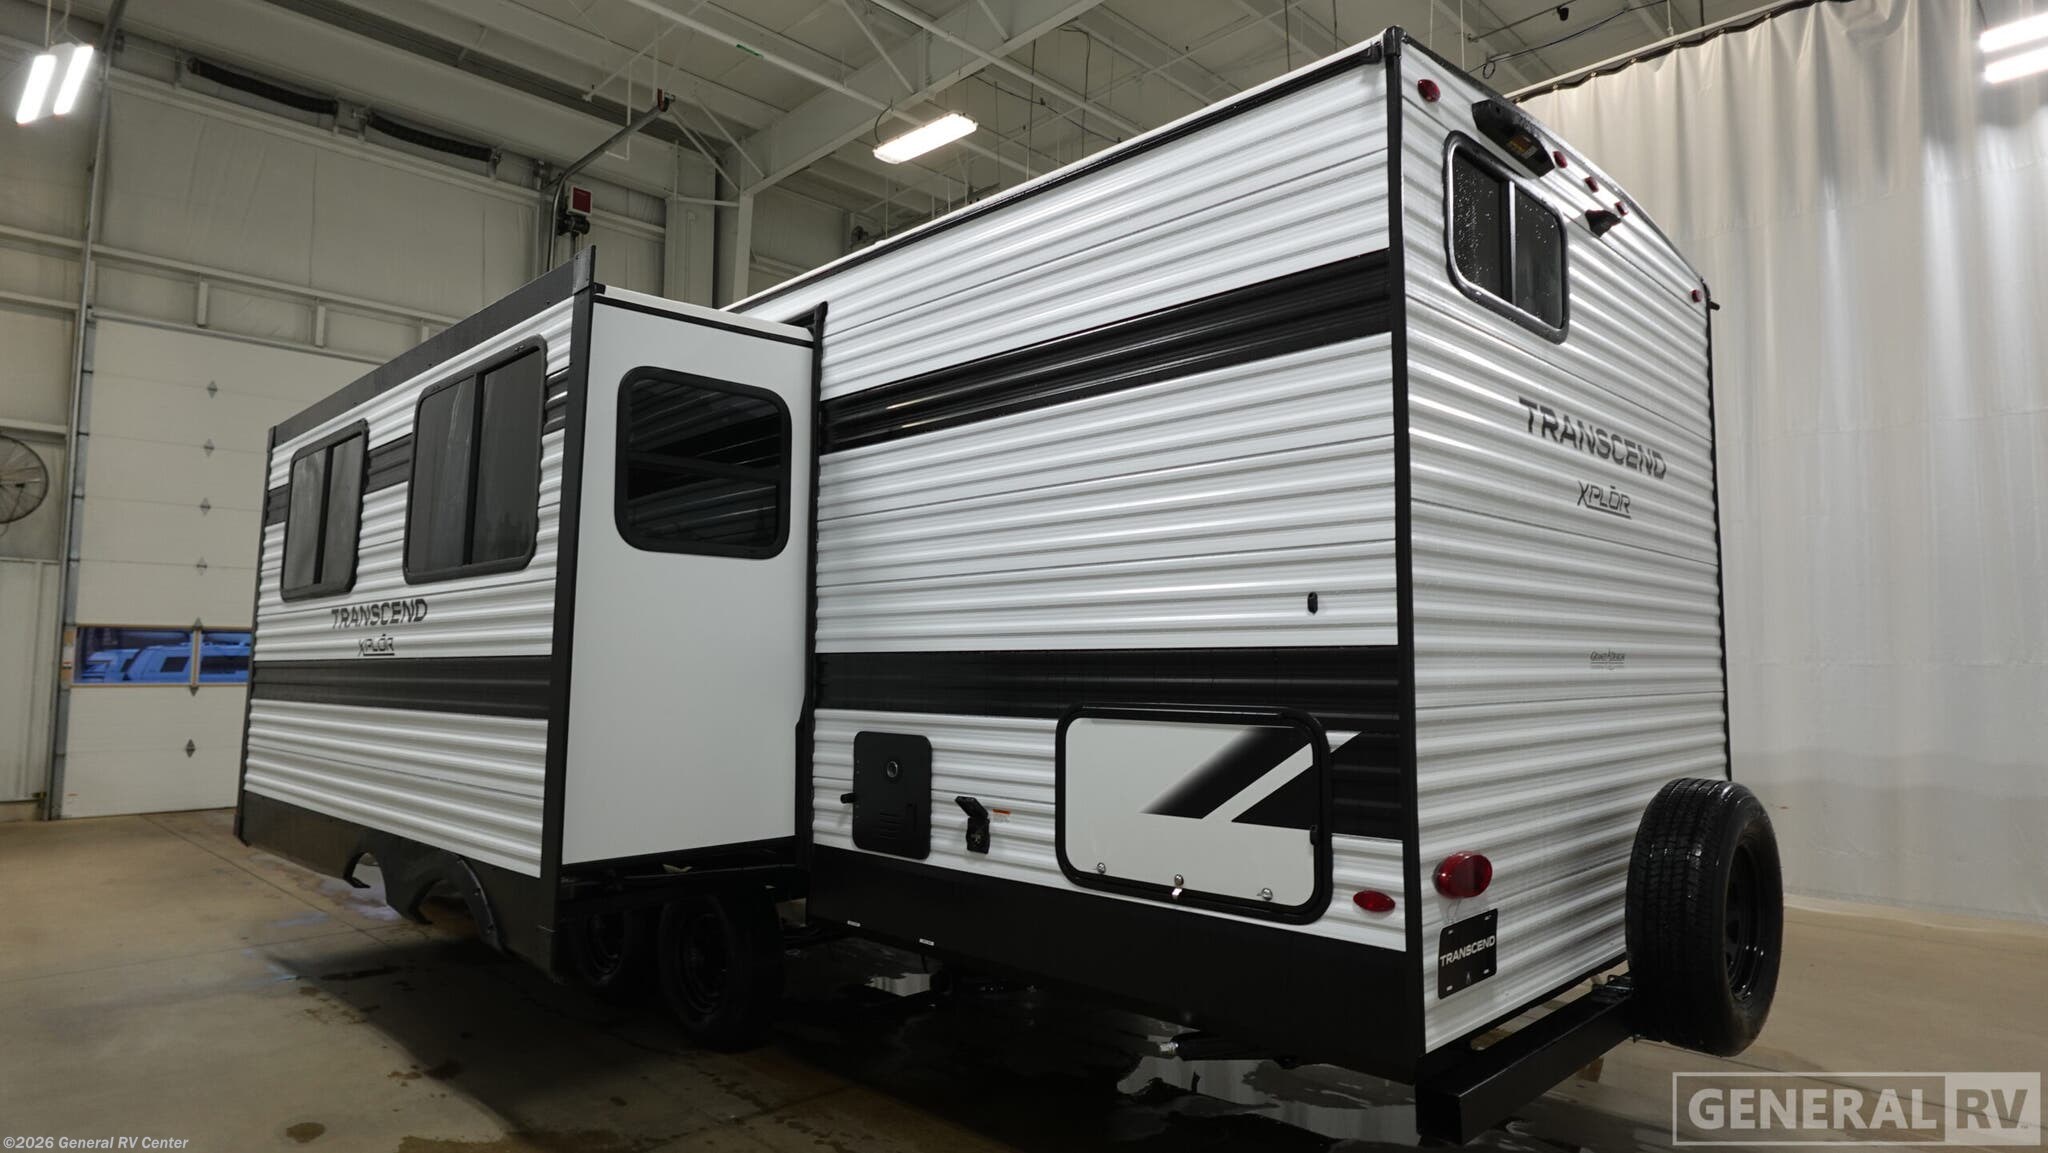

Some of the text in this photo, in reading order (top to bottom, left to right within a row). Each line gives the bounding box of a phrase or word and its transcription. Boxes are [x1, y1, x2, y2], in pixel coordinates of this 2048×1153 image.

[1519, 396, 1668, 480] TRANSCEND
[331, 598, 428, 629] TRANSCEND
[1439, 934, 1496, 968] TRANSCEND
